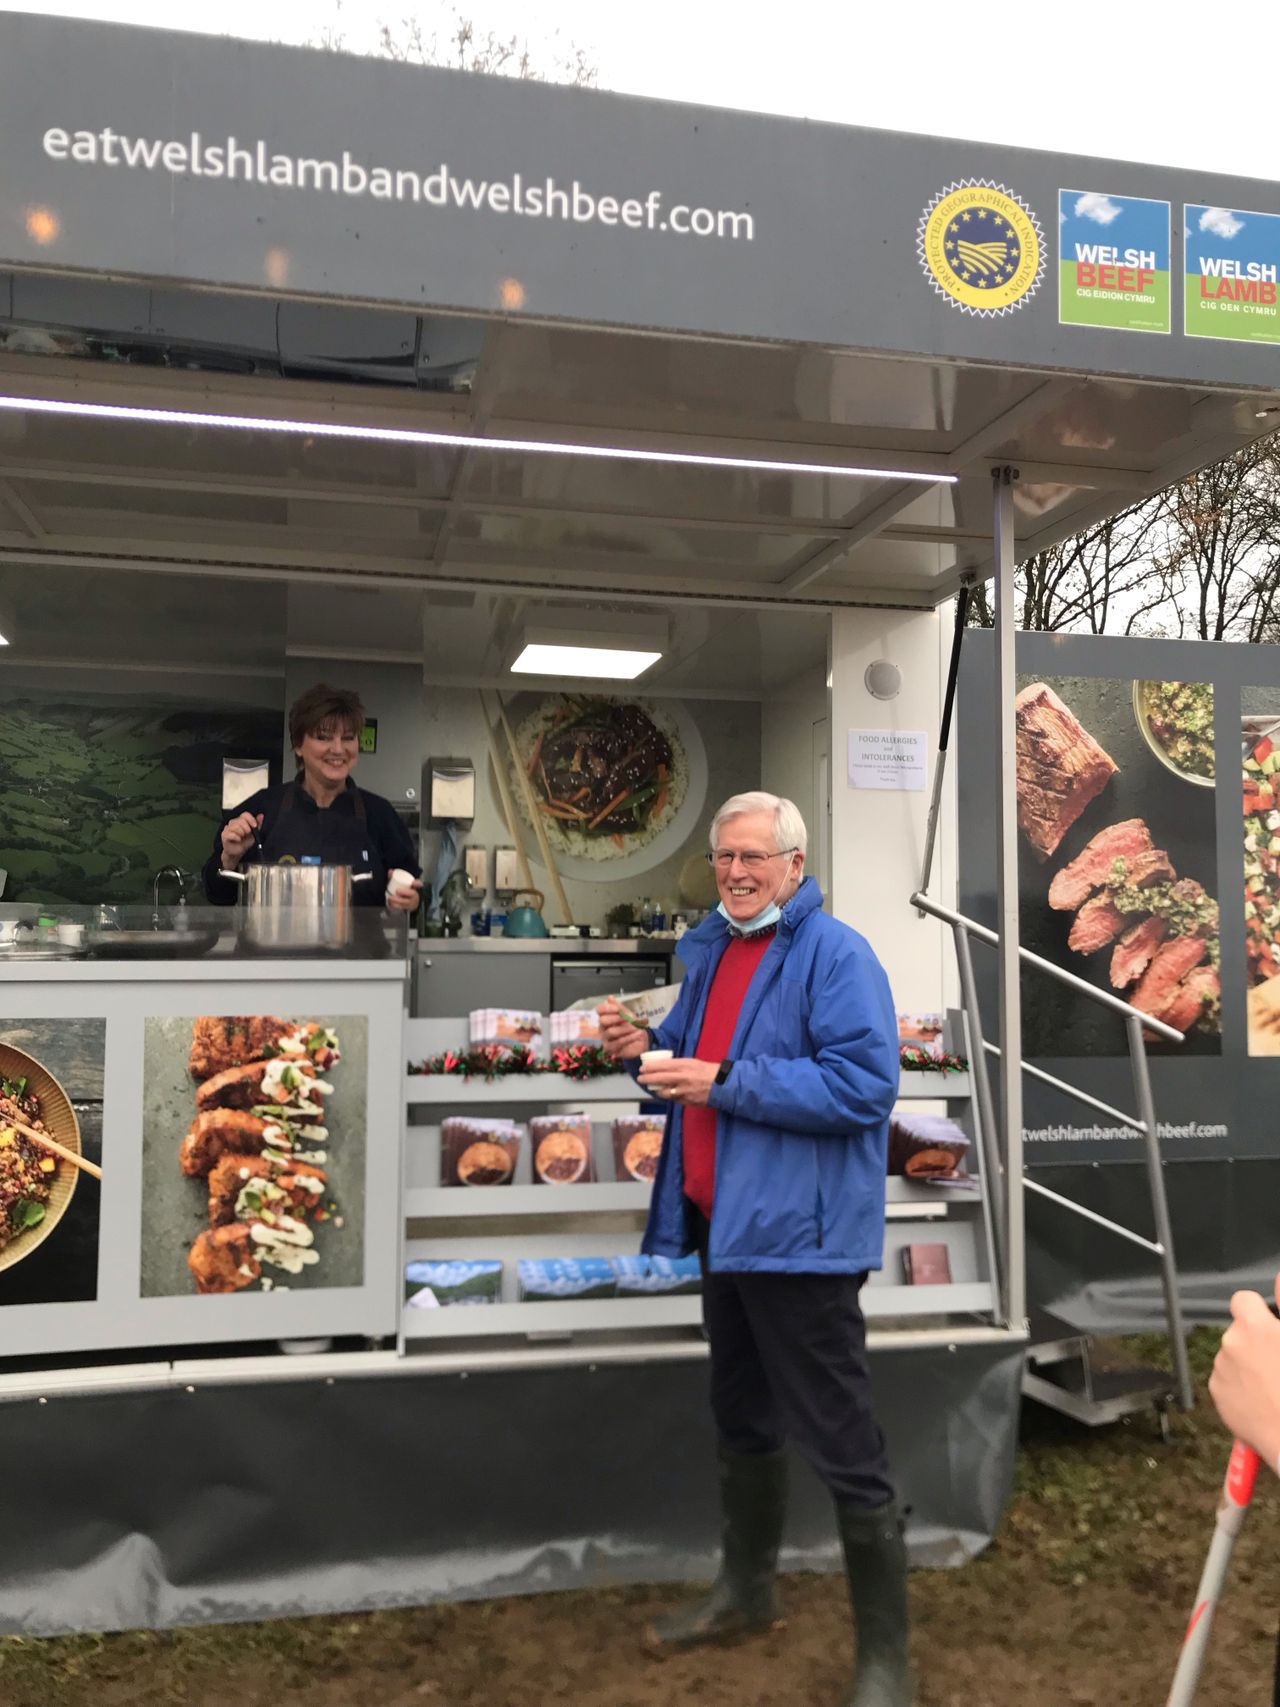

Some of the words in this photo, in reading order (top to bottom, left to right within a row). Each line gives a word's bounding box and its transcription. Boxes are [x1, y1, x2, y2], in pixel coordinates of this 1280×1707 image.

[42, 126, 755, 240] eatwelshlambandwelshbeef.com
[941, 193, 1024, 224] GEOGRAPHICAL
[930, 218, 956, 289] PROTECTED
[1009, 227, 1034, 294] INDICATION
[1075, 242, 1155, 270] WELSH
[1077, 262, 1155, 292] BEEF
[1199, 256, 1276, 283] WELSH
[1076, 288, 1092, 298] CIG
[1093, 290, 1124, 301] EIDION
[1124, 293, 1155, 304] CYMRU
[1200, 275, 1277, 304] LAMB
[1200, 301, 1217, 310] CIG
[1220, 303, 1240, 312] OEN
[1243, 305, 1277, 316] CYMRU
[858, 735, 880, 744] FOOD
[881, 736, 918, 745] ALLERGIES
